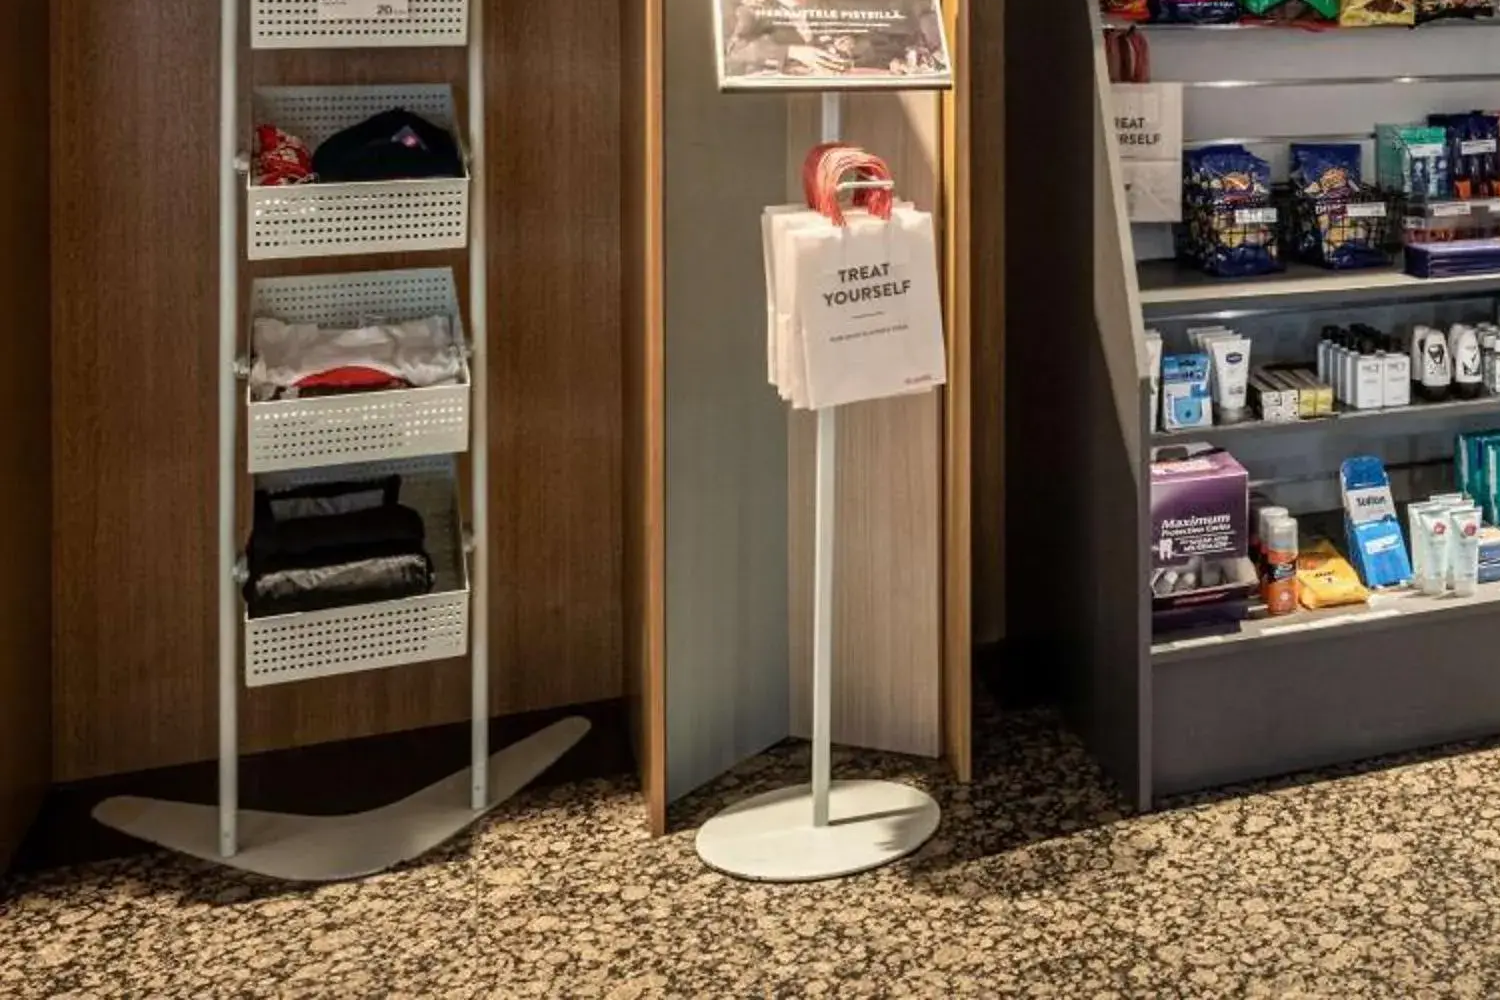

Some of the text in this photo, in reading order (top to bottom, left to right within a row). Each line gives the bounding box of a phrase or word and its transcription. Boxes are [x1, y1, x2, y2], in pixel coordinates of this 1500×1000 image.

[837, 262, 890, 284] TREAT
[822, 279, 911, 307] YOURSELF
[1161, 513, 1231, 530] Maximum
